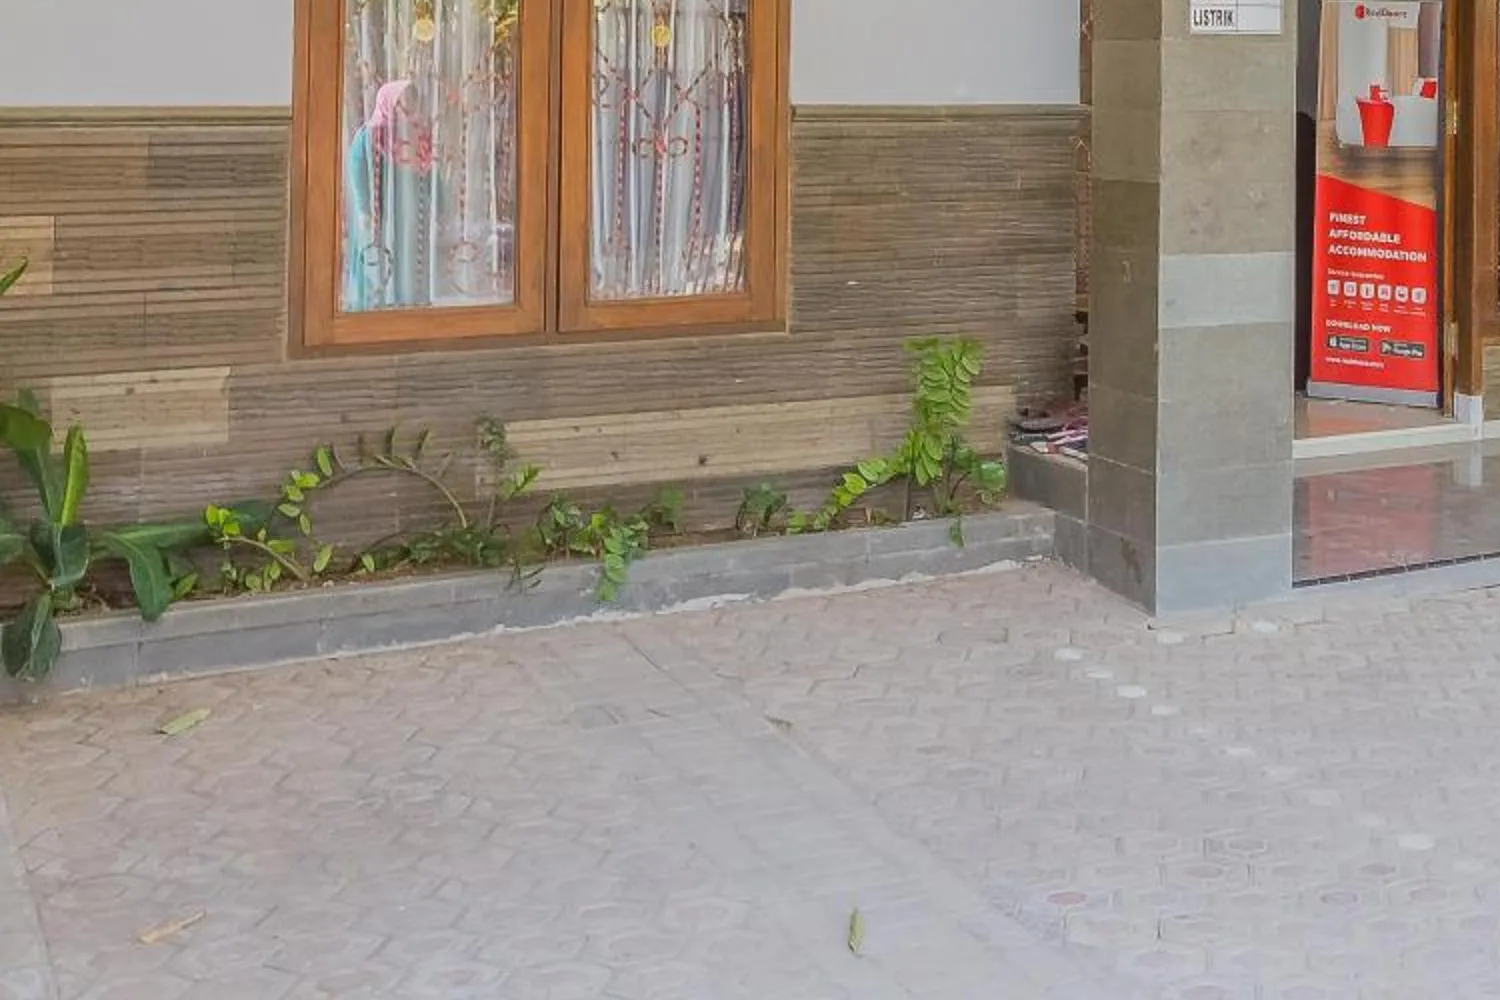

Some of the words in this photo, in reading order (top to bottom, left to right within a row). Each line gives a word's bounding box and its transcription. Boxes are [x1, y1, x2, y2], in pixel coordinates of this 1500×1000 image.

[1193, 9, 1233, 26] LISTRIK
[1329, 212, 1366, 225] FINEST
[1328, 228, 1401, 244] AFFORDABLE
[1328, 244, 1427, 262] ACCOMMODATION
